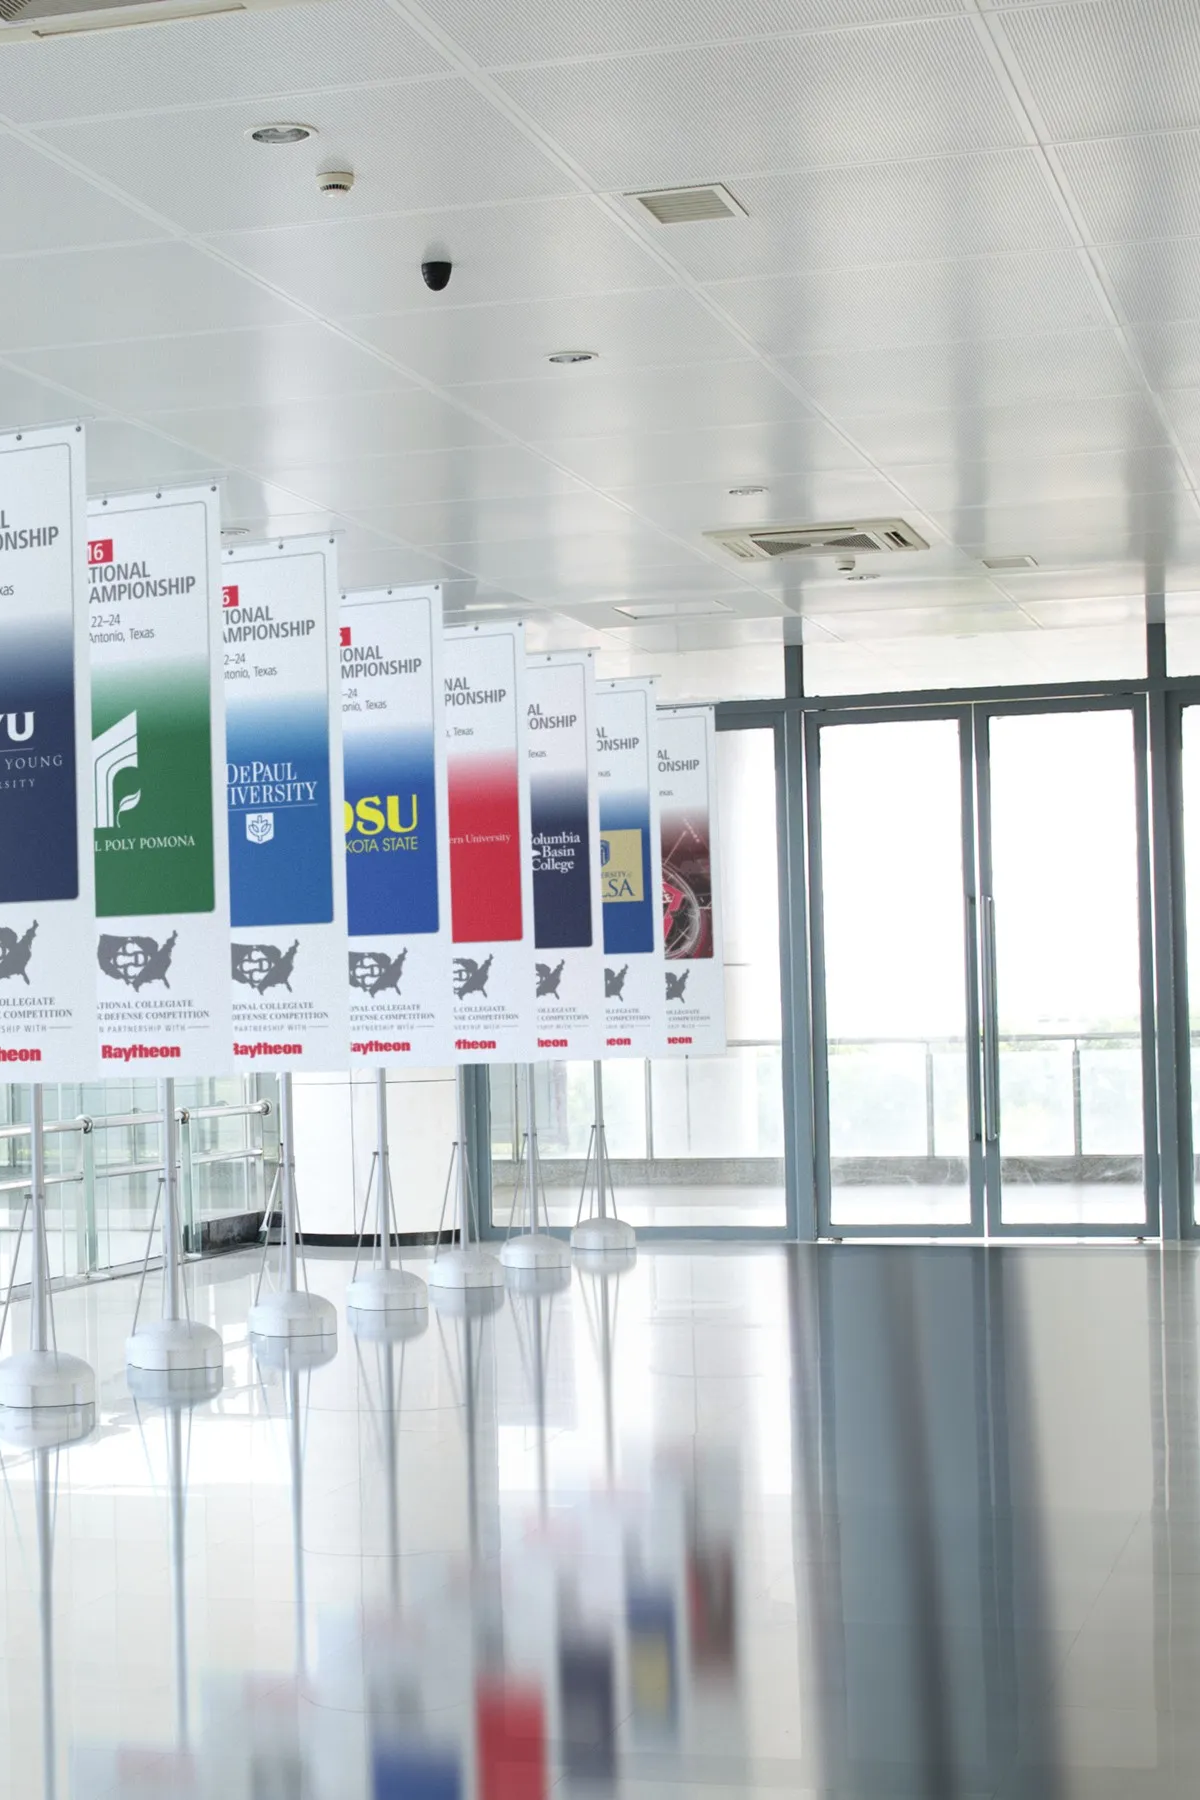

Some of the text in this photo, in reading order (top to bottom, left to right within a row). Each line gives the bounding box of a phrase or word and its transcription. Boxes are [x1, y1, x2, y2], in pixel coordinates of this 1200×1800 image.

[88, 544, 103, 561] 16
[88, 561, 150, 584] TIONAL
[89, 576, 195, 604] AMPIONSHIP
[223, 606, 273, 625] IONAL
[129, 628, 154, 640] Texas
[223, 620, 315, 643] MPIONSHIP
[224, 653, 245, 665] 2–24
[252, 666, 277, 677] Texas
[341, 658, 422, 679] MPIONSHIP
[365, 700, 387, 710] Texas
[445, 689, 506, 706] PIONSHIP
[453, 727, 473, 736] Texas
[5, 755, 63, 770] YOUNG
[228, 781, 317, 805] IVERSITY
[105, 838, 135, 851] POLY
[140, 835, 195, 848] POMONA
[383, 836, 418, 852] STATE
[465, 832, 511, 844] University
[533, 832, 581, 844] olumbia
[542, 845, 575, 857] Basin
[136, 1000, 193, 1008] COLLEGIATE
[260, 1002, 313, 1010] COLLEGIATE
[4, 1009, 72, 1019] COMPETITION
[104, 1012, 142, 1020] DEFENSE
[102, 1044, 181, 1062] Raytheon
[351, 1040, 411, 1055] aytheon
